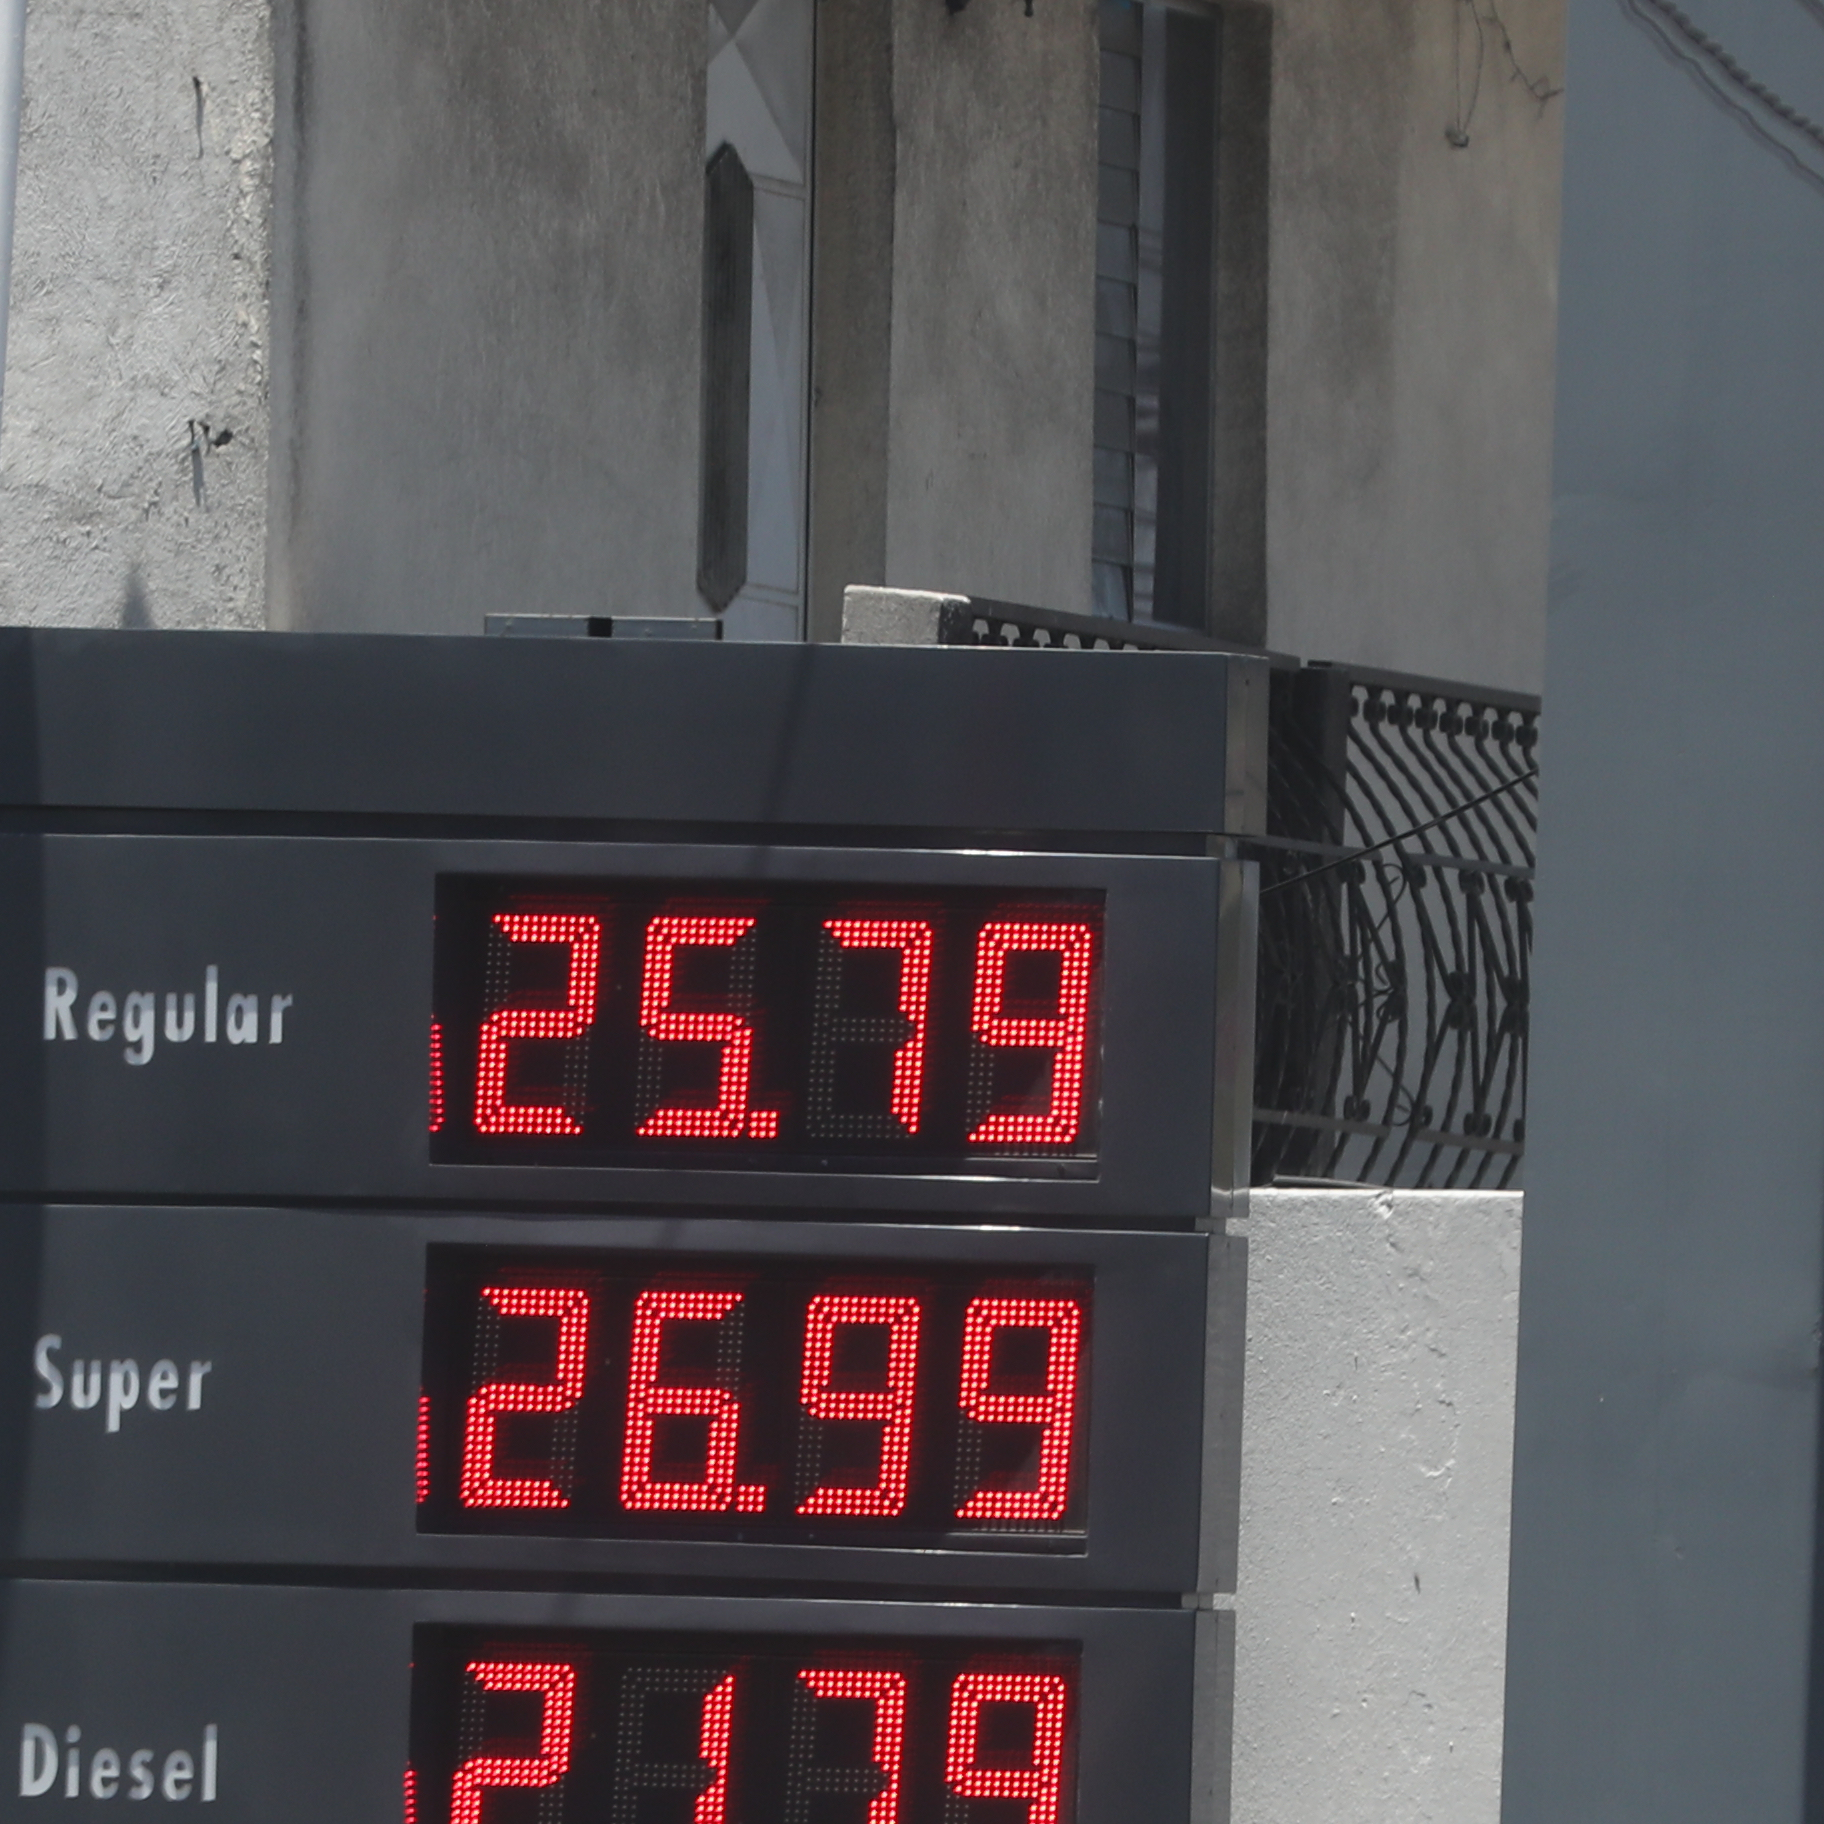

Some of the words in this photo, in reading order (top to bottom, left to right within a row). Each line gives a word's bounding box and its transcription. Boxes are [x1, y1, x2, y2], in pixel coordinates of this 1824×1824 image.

[42, 963, 294, 1067] Regular
[473, 914, 1093, 1144] 25.79
[32, 1333, 213, 1434] Super
[460, 1287, 1080, 1520] 26.99
[19, 1722, 218, 1803] Diesel
